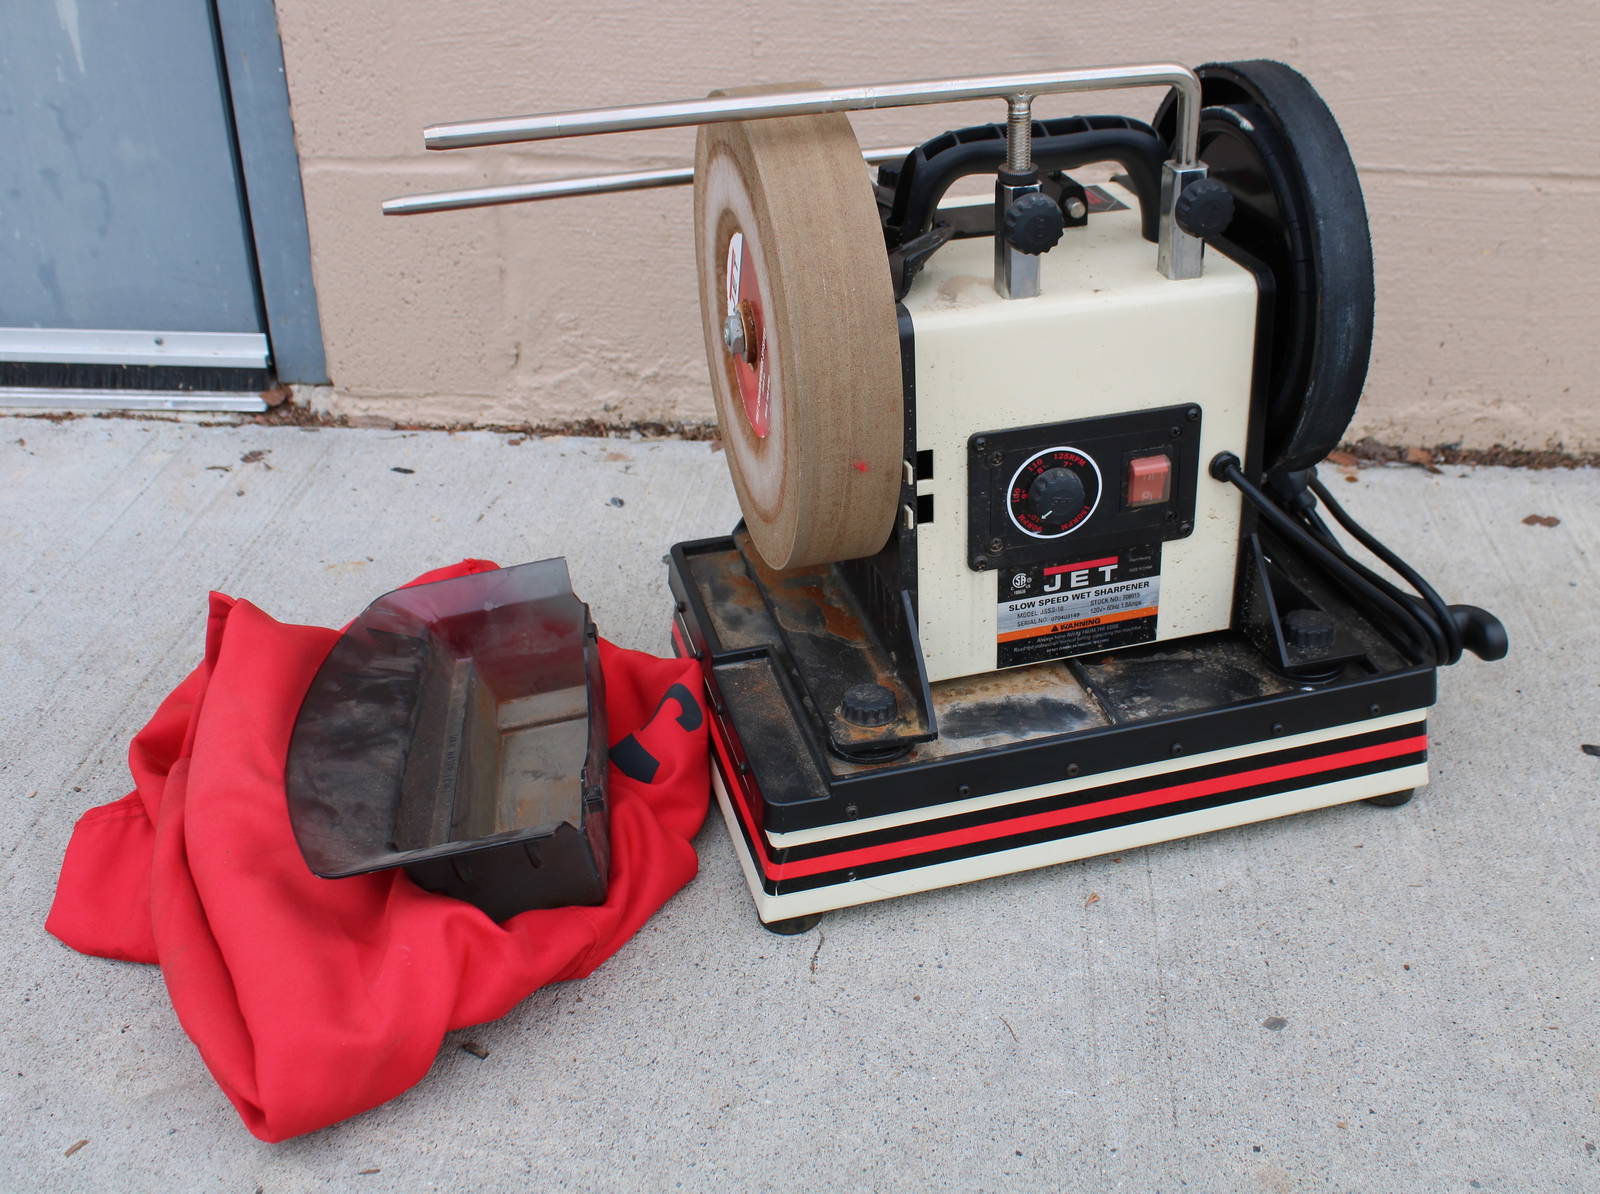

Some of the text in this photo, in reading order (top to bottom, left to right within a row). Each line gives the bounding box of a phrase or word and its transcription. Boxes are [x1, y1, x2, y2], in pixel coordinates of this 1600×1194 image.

[1043, 564, 1118, 592] JET
[1009, 581, 1150, 612] SLOW SPEED WET SHARPENER
[1090, 597, 1108, 606] STOCK
[1017, 619, 1037, 627] SERIAL
[1060, 617, 1101, 630] WARNING
